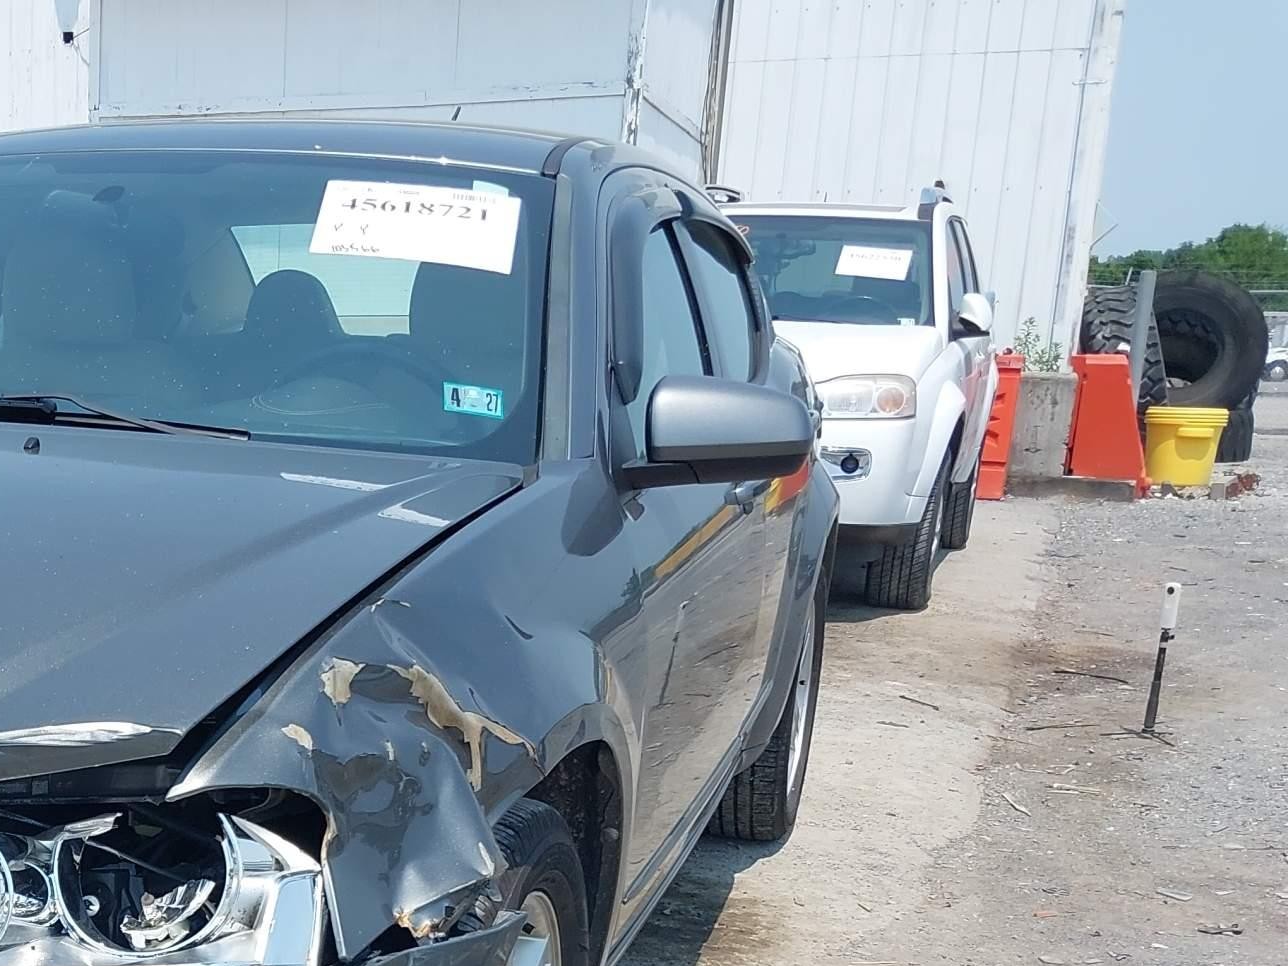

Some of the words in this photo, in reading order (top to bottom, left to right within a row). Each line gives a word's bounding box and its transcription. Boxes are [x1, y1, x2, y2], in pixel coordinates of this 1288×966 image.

[341, 197, 487, 221] 45618721
[451, 387, 461, 408] 4
[485, 392, 499, 414] 27
